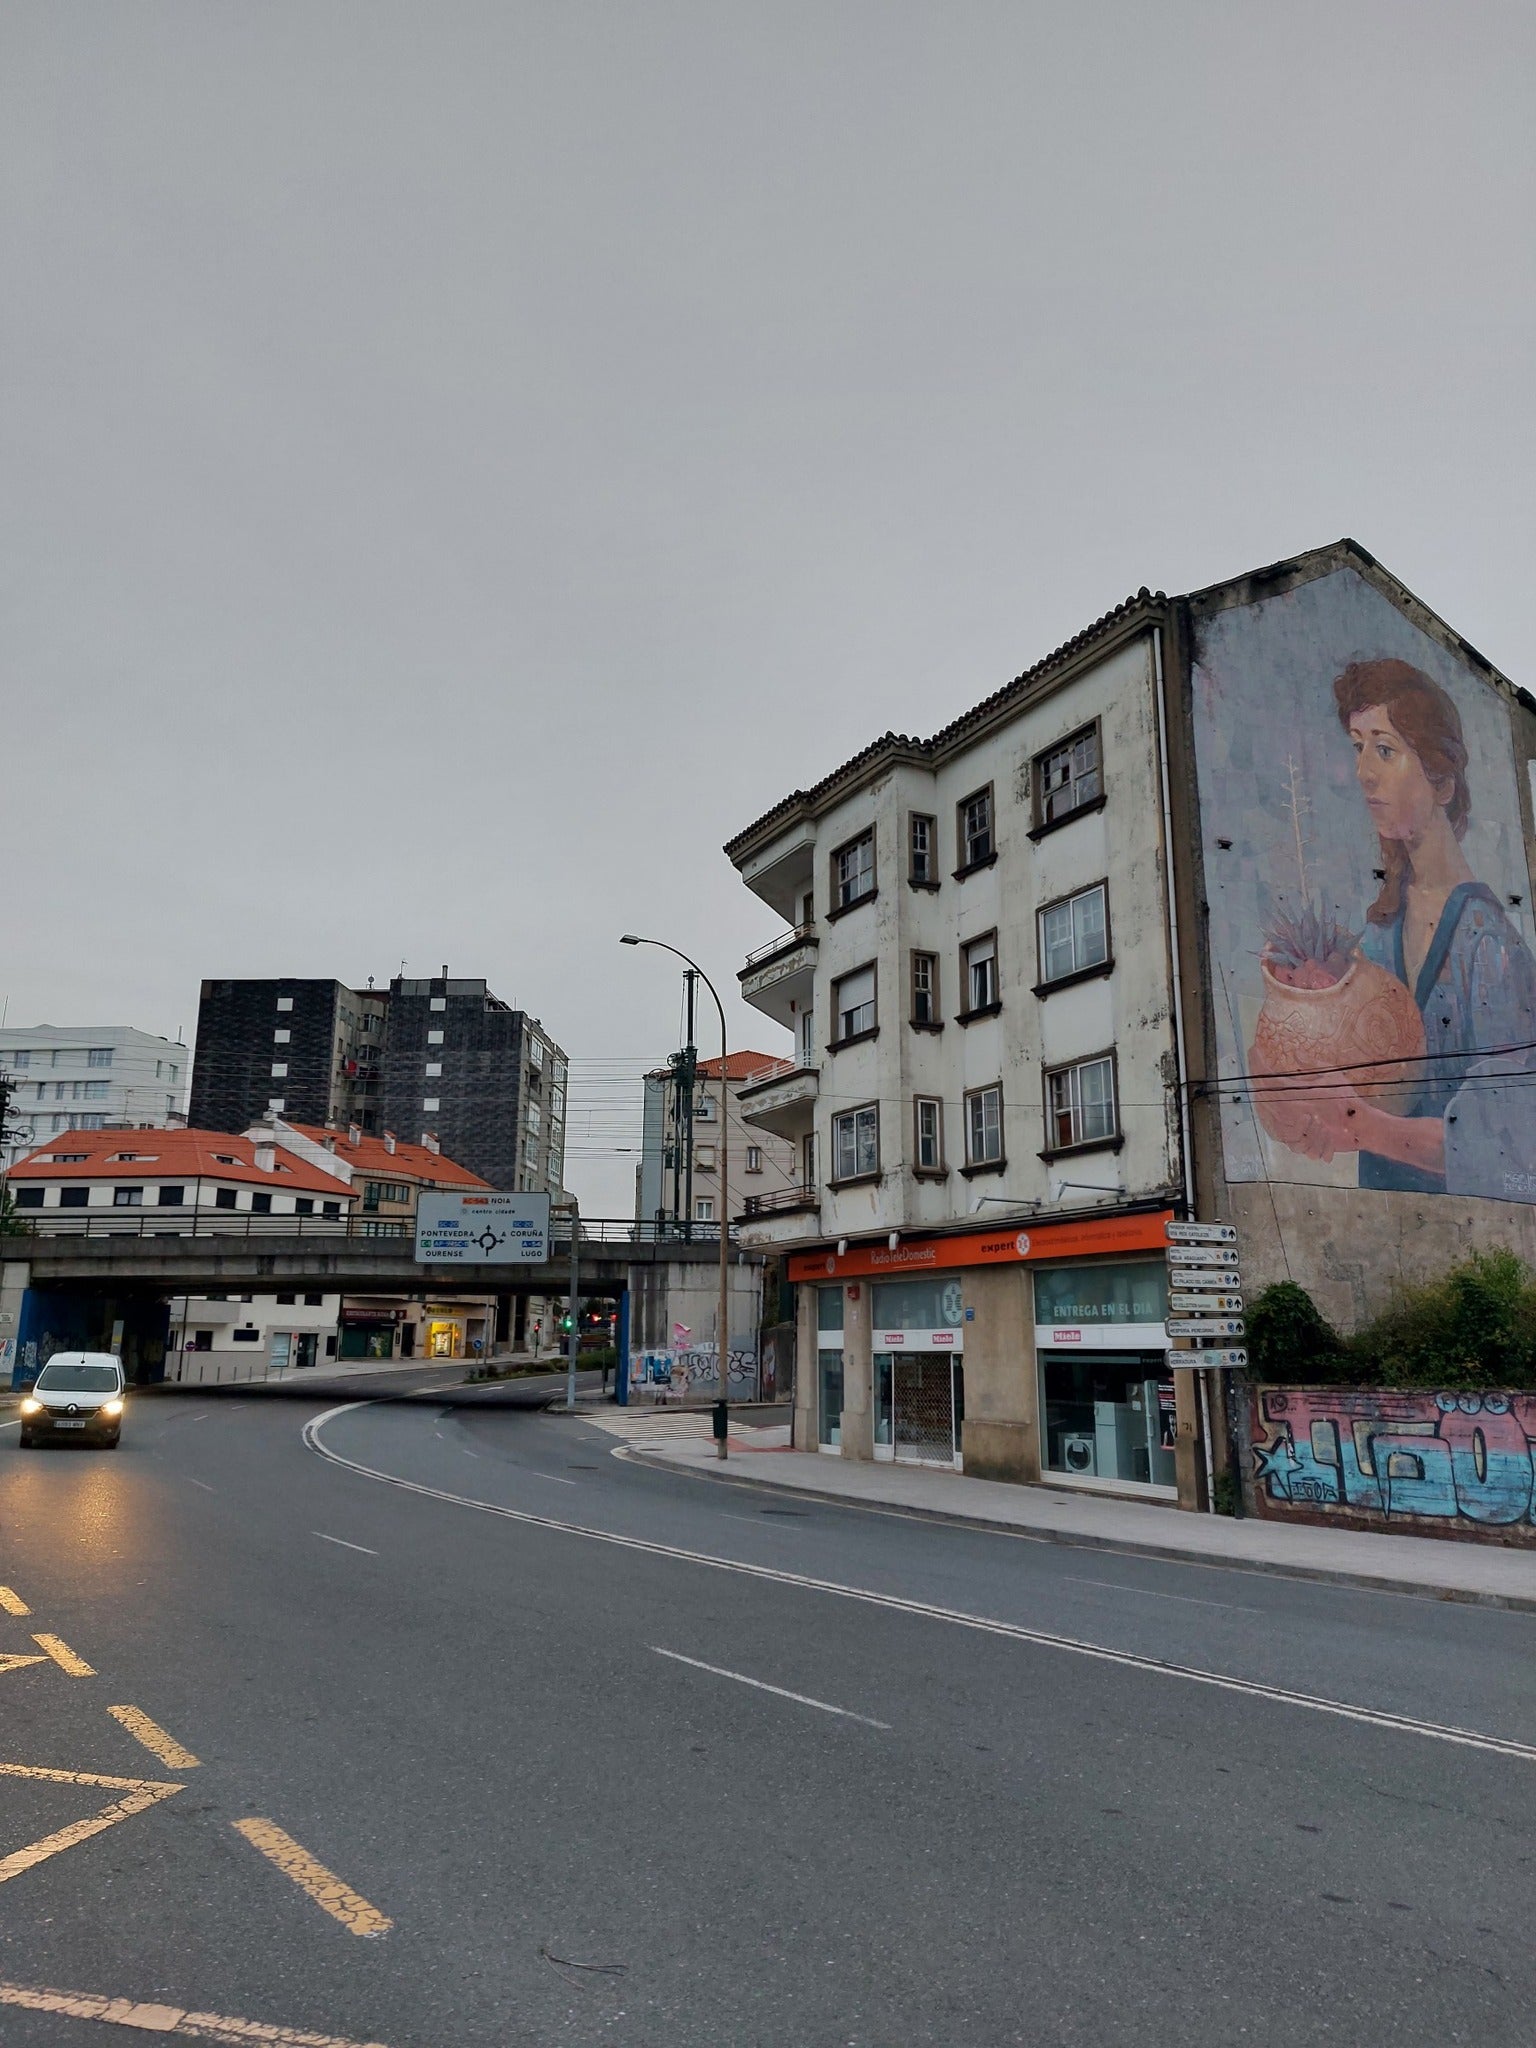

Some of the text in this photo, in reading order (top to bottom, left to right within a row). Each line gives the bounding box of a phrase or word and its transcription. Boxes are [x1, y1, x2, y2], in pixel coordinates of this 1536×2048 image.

[510, 1229, 544, 1237] CORUÑA
[981, 1240, 1015, 1254] expert
[870, 1247, 937, 1265] RadioTeleDomestic
[1053, 1305, 1099, 1317] ENTREGA
[1101, 1303, 1116, 1316] EN
[1119, 1303, 1130, 1315] EL
[885, 1334, 904, 1343] Miele
[933, 1334, 953, 1343] Miele
[1054, 1331, 1081, 1341] Miele
